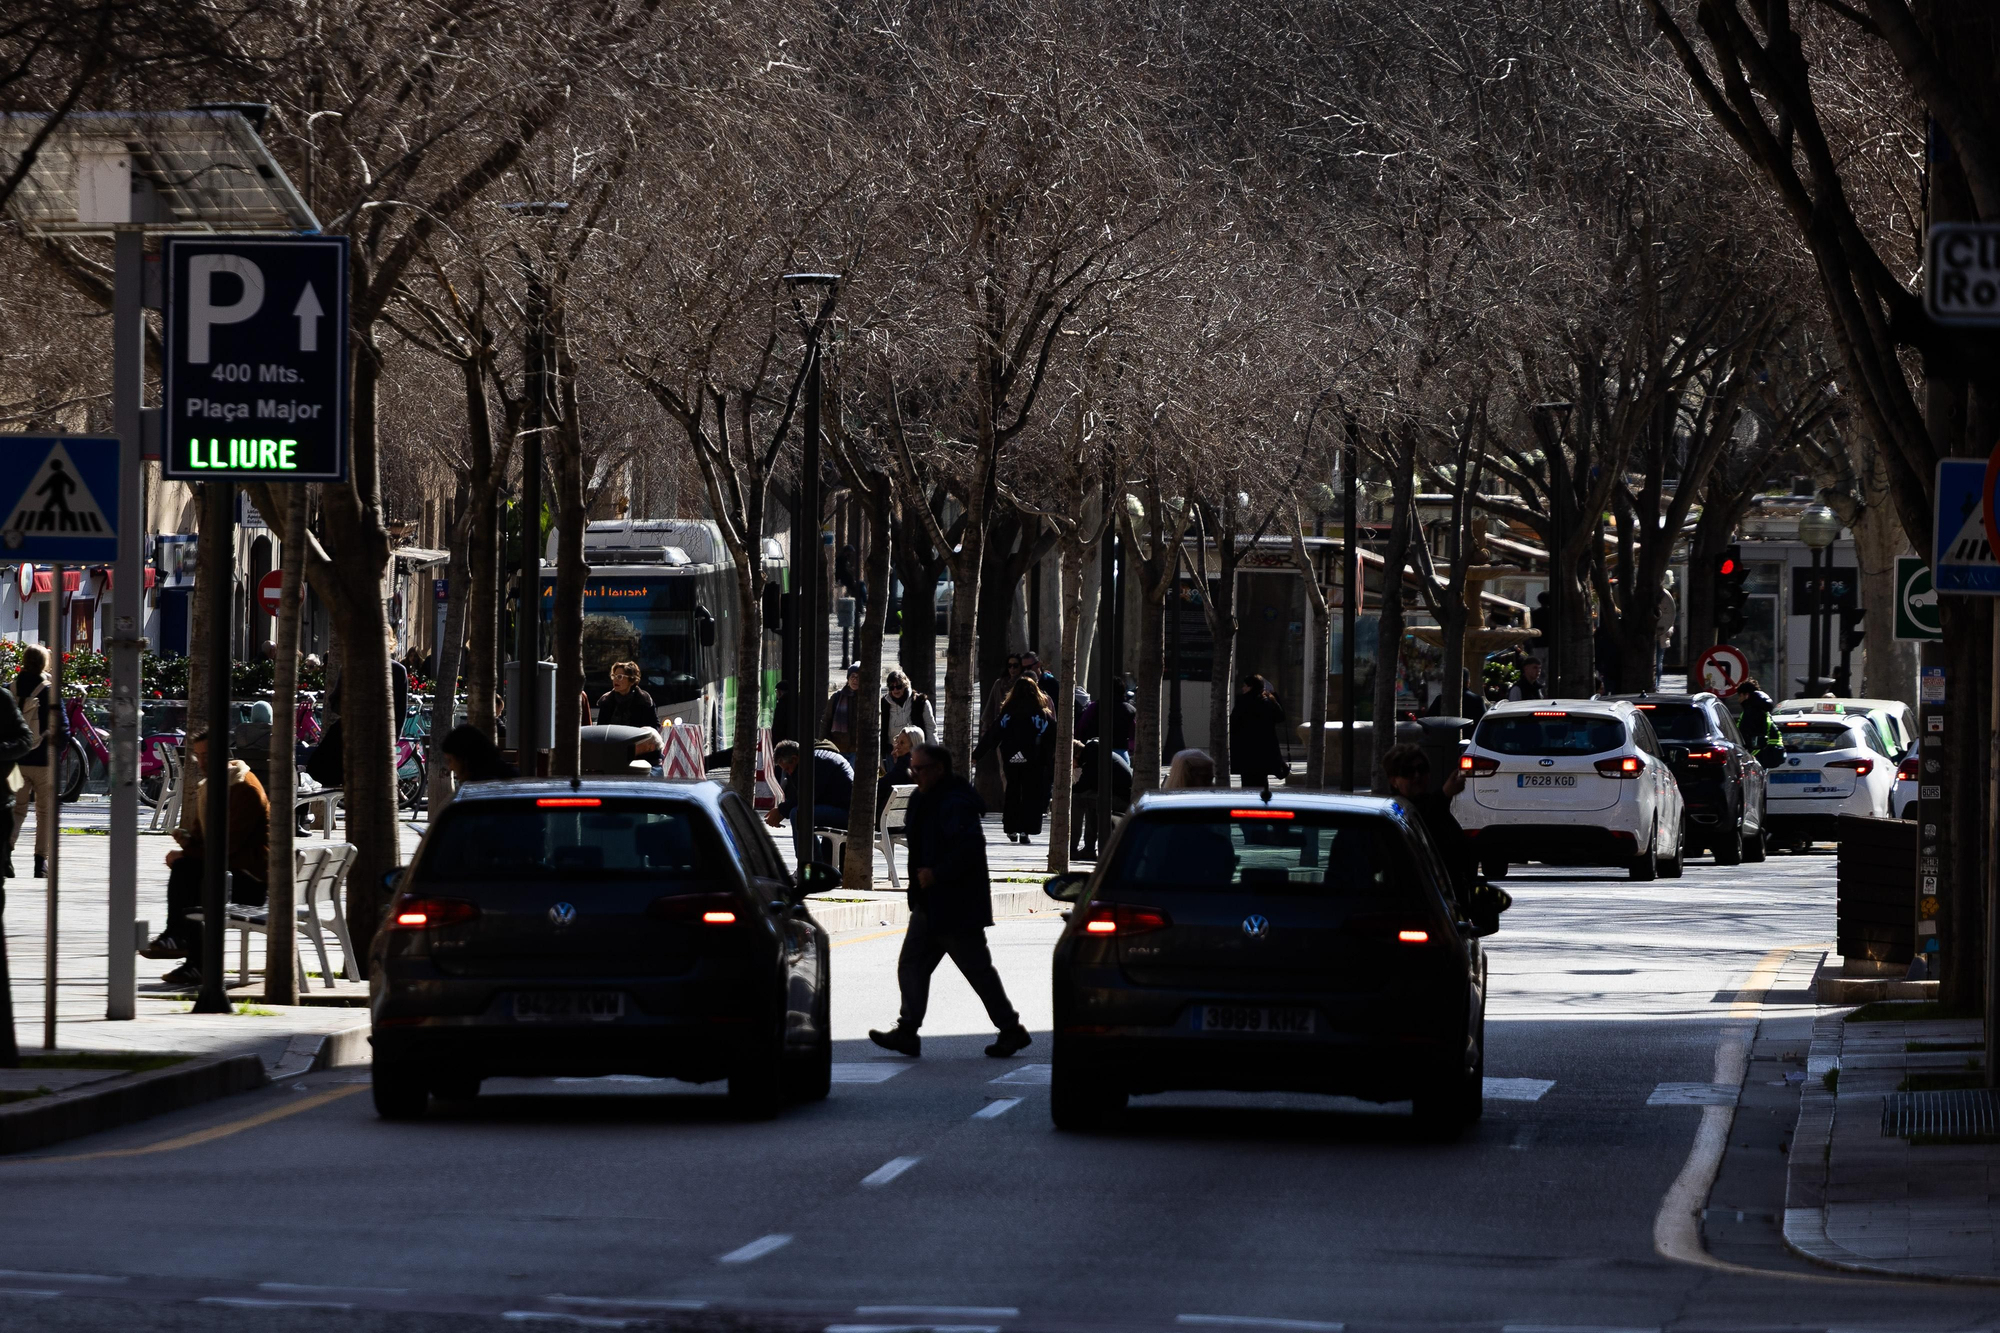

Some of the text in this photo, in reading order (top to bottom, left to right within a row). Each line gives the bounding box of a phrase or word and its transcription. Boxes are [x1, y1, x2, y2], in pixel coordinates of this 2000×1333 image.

[1944, 271, 1998, 306] Ro
[187, 253, 265, 364] P
[211, 364, 305, 383] 400 Mts.
[186, 398, 322, 424] Plaça Major
[189, 438, 298, 470] LLIURE
[1525, 776, 1575, 786] 7628 KGD
